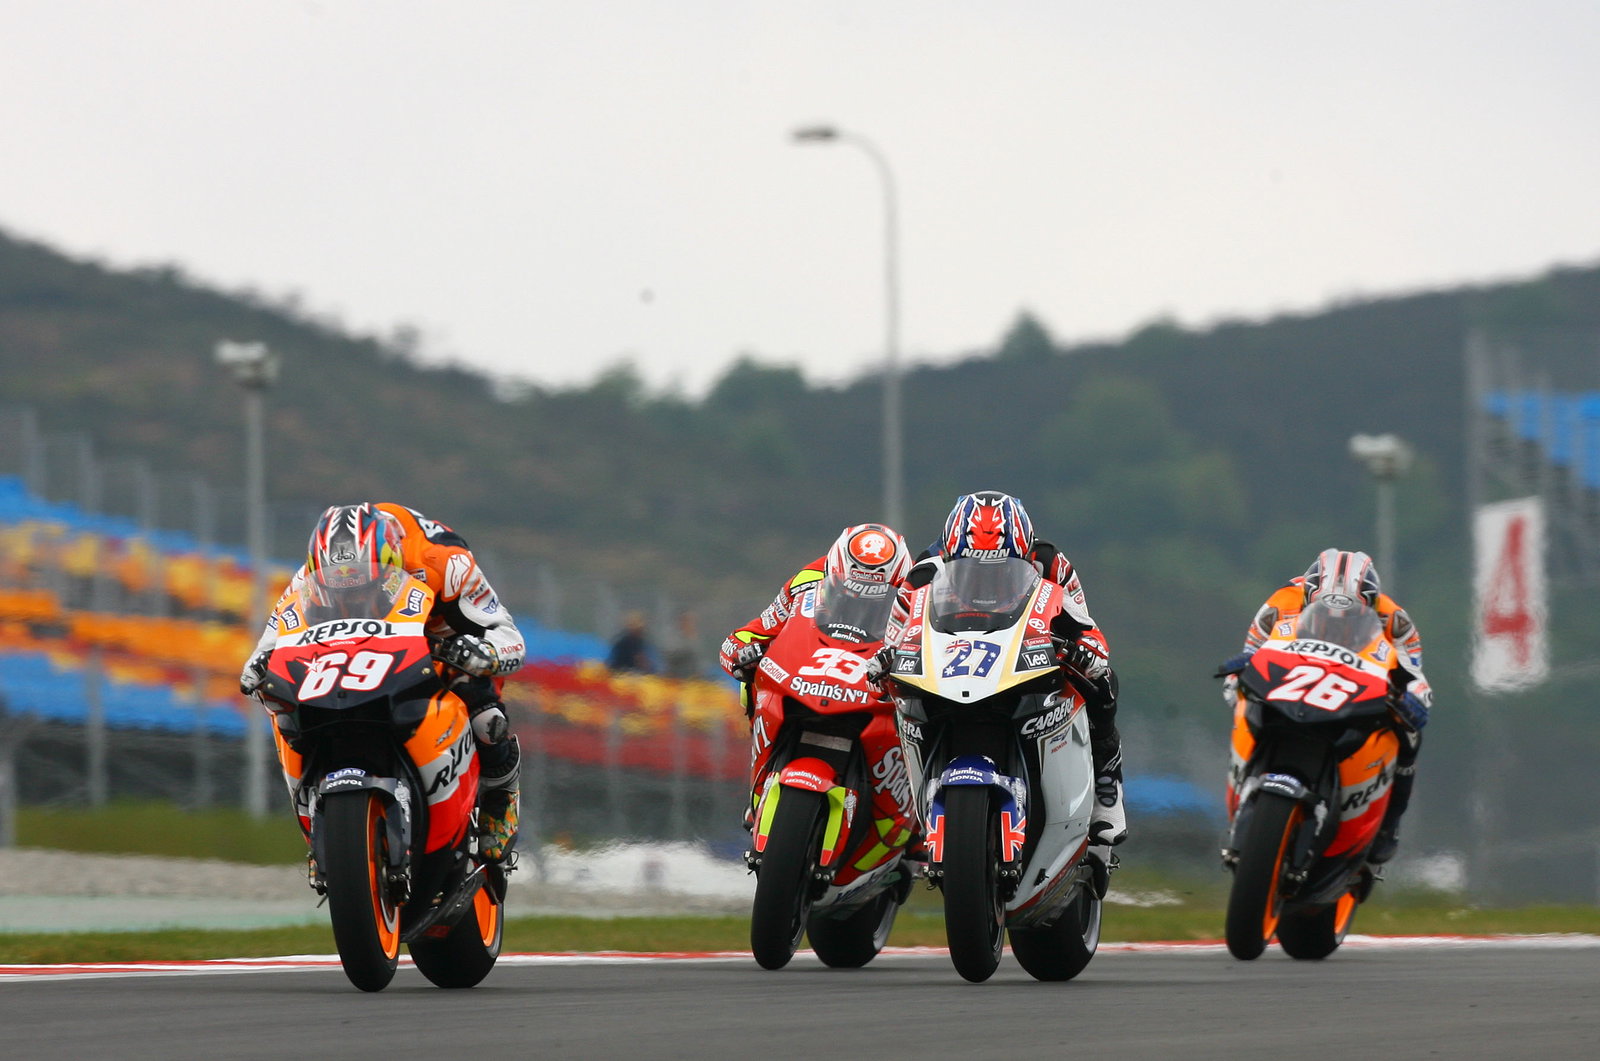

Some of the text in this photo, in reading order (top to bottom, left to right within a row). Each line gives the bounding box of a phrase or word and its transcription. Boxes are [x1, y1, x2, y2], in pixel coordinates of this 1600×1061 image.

[961, 547, 1010, 564] NOLAN
[843, 578, 890, 598] NOLAN
[1034, 582, 1054, 614] CARRERA
[1483, 517, 1536, 666] 4
[913, 587, 926, 619] CARRERA
[296, 621, 397, 646] REPSOL
[827, 622, 868, 637] HONDA
[831, 629, 861, 644] domino
[798, 648, 868, 685] 33
[898, 657, 915, 672] Lee
[942, 639, 1002, 678] 27
[1025, 652, 1049, 667] Lee
[1283, 641, 1367, 671] REPSOL
[298, 650, 396, 703] 69
[763, 661, 786, 682] Castrol
[789, 676, 843, 702] Spain's
[1266, 666, 1358, 711] 26
[1020, 694, 1076, 735] CARRERA
[948, 775, 984, 783] HONDA
[950, 766, 983, 777] domino
